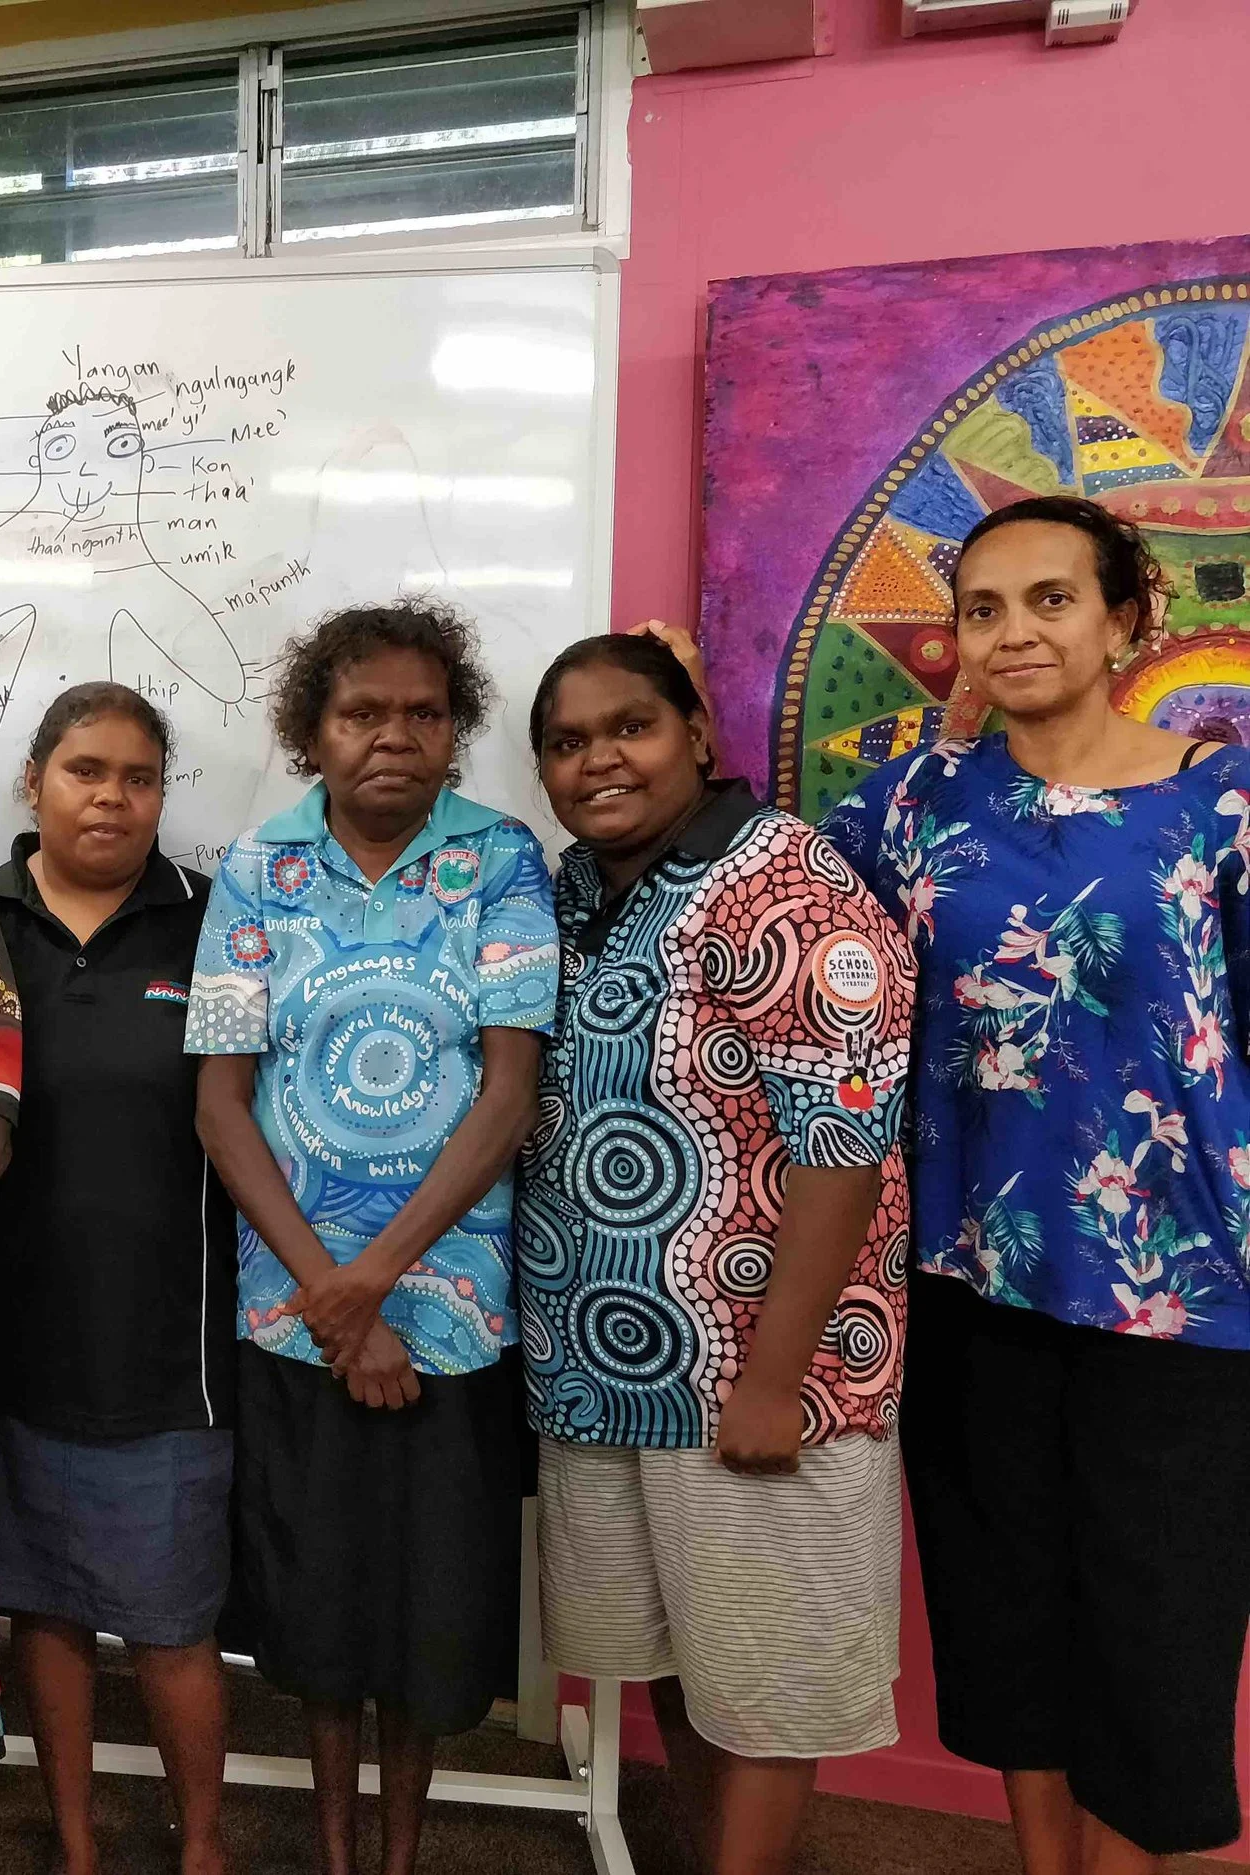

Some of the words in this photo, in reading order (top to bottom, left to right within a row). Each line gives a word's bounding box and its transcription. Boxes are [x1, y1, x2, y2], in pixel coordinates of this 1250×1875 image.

[303, 955, 417, 1003] Languages
[827, 971, 877, 981] ATTENDANCE
[828, 958, 875, 971] SCHOOL
[325, 1010, 375, 1076] cultural
[330, 1078, 434, 1119] Knowledge
[282, 1084, 343, 1171] Connection
[368, 1157, 424, 1178] with
